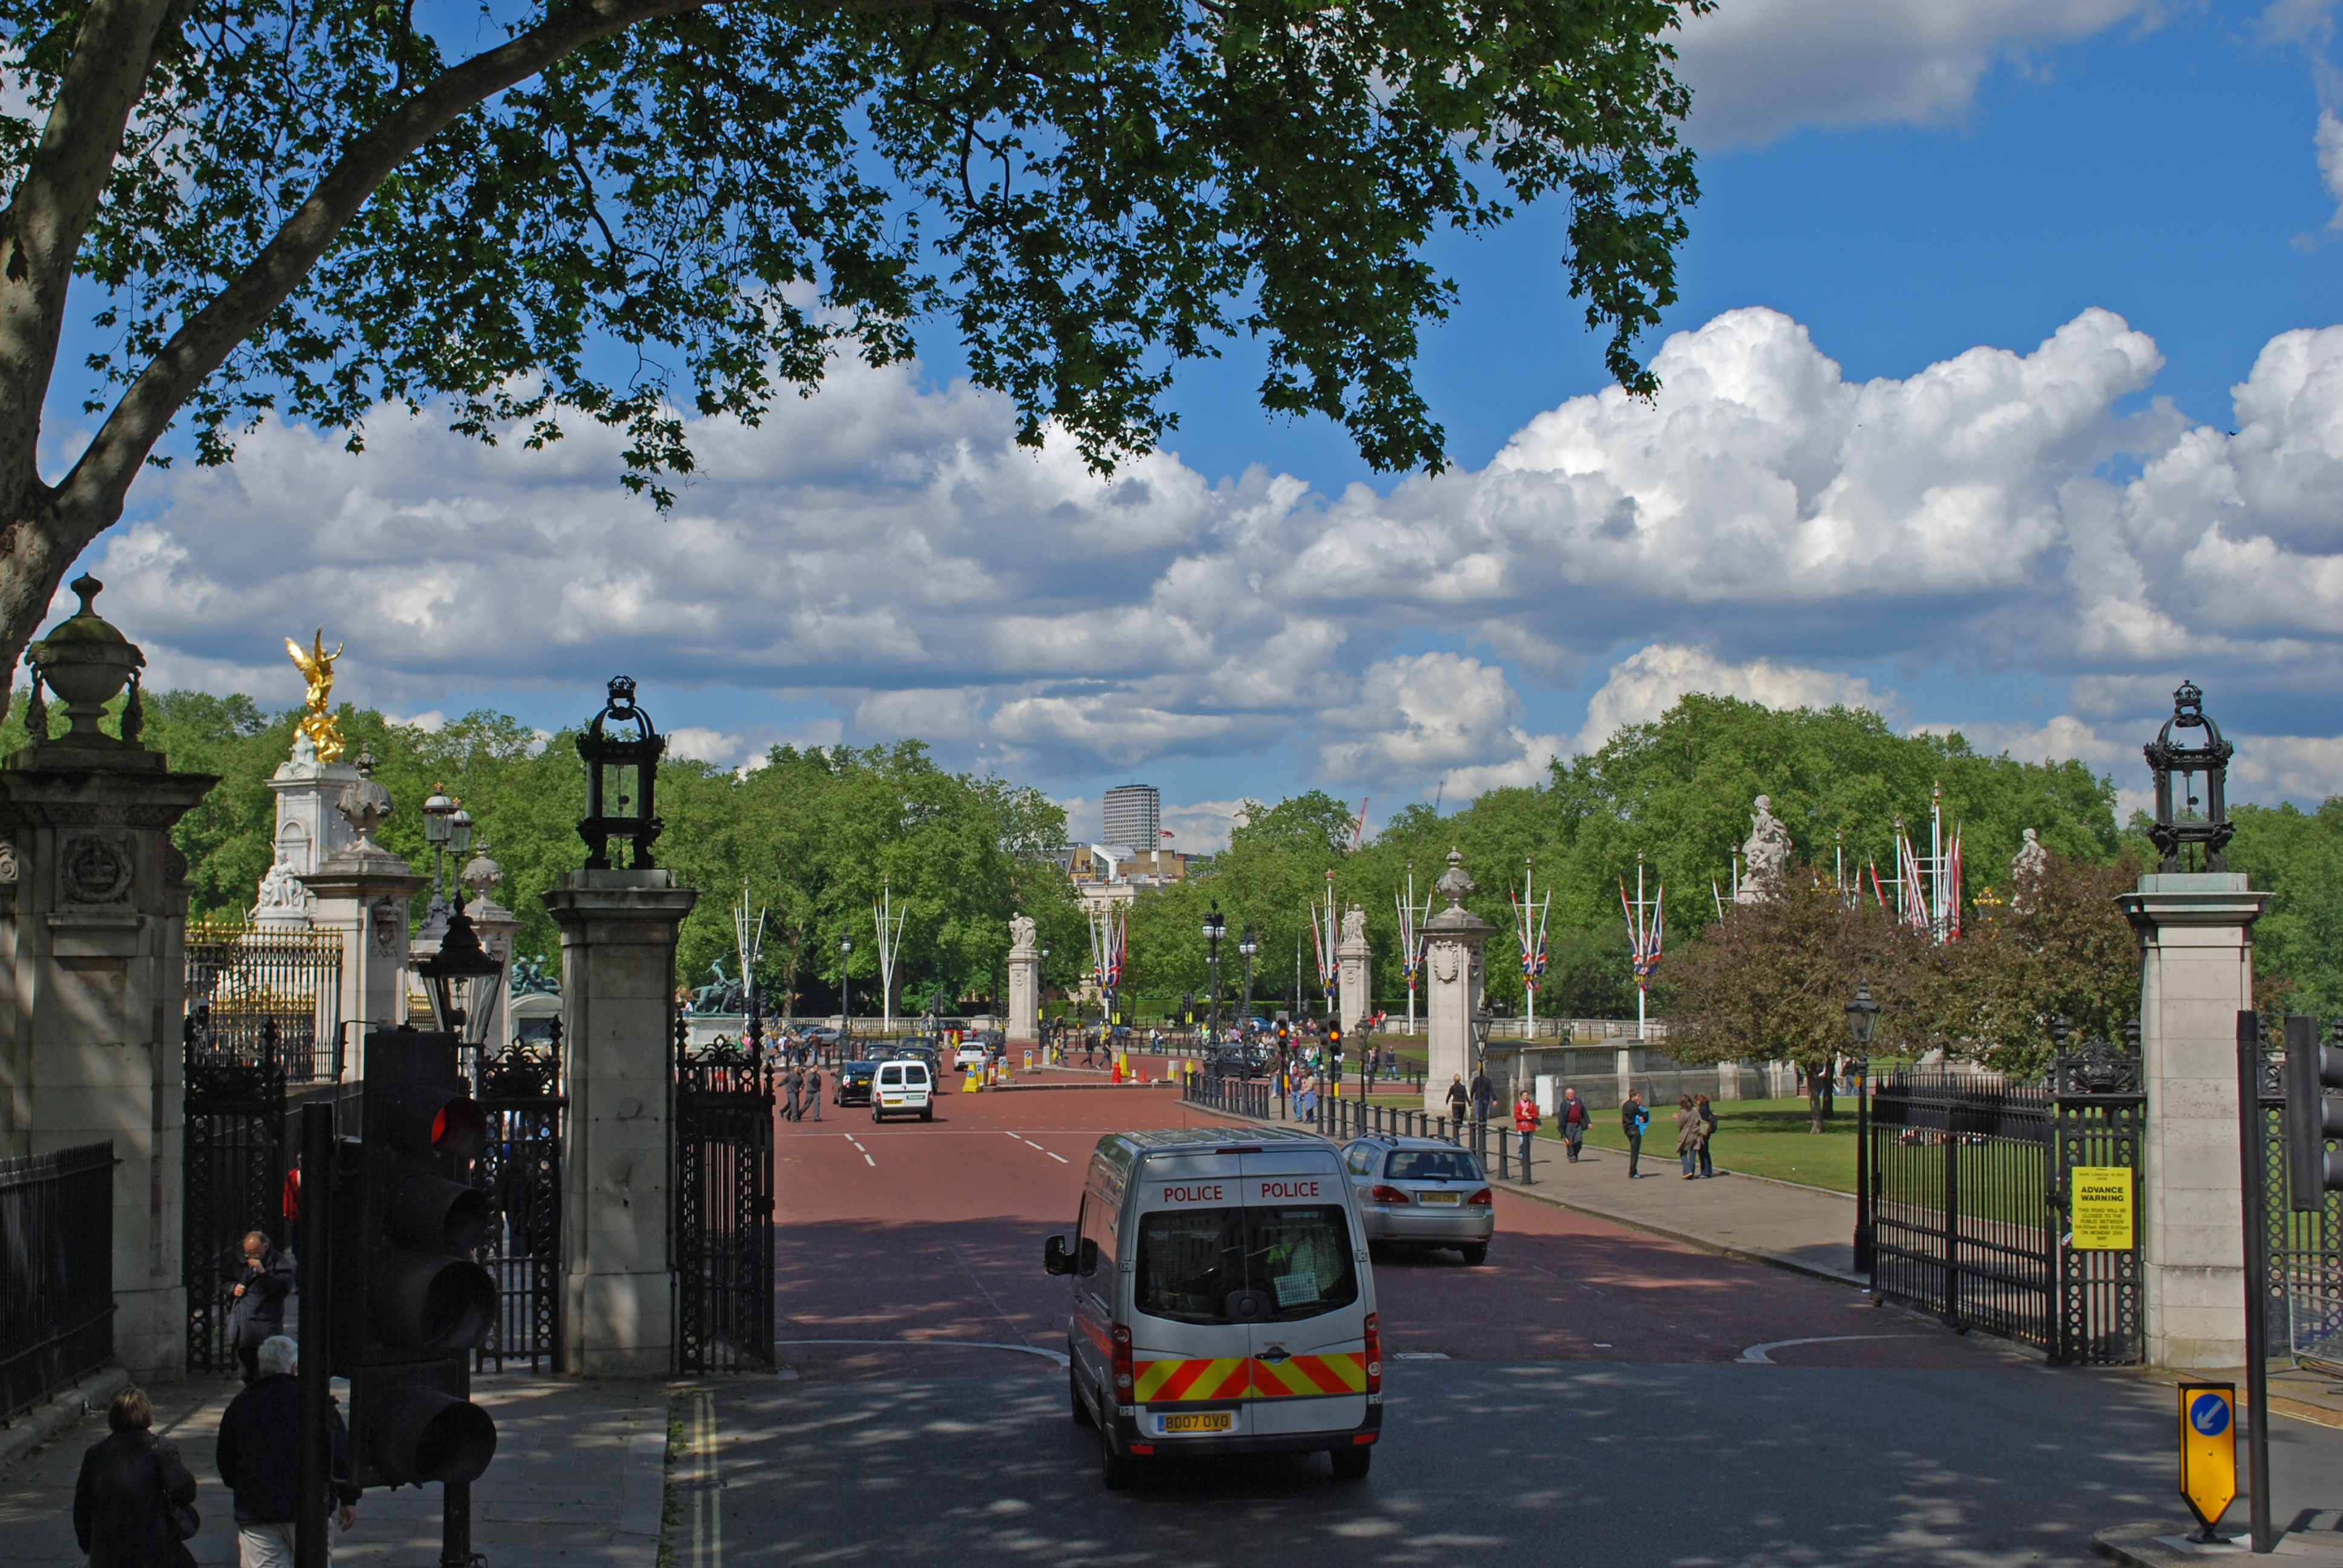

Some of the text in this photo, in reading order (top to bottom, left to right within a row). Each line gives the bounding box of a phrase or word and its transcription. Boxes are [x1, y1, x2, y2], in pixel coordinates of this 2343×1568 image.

[1164, 1186, 1222, 1203] POLICE
[1261, 1182, 1319, 1198] POLICE
[1165, 1415, 1228, 1428] BD07 OVO
